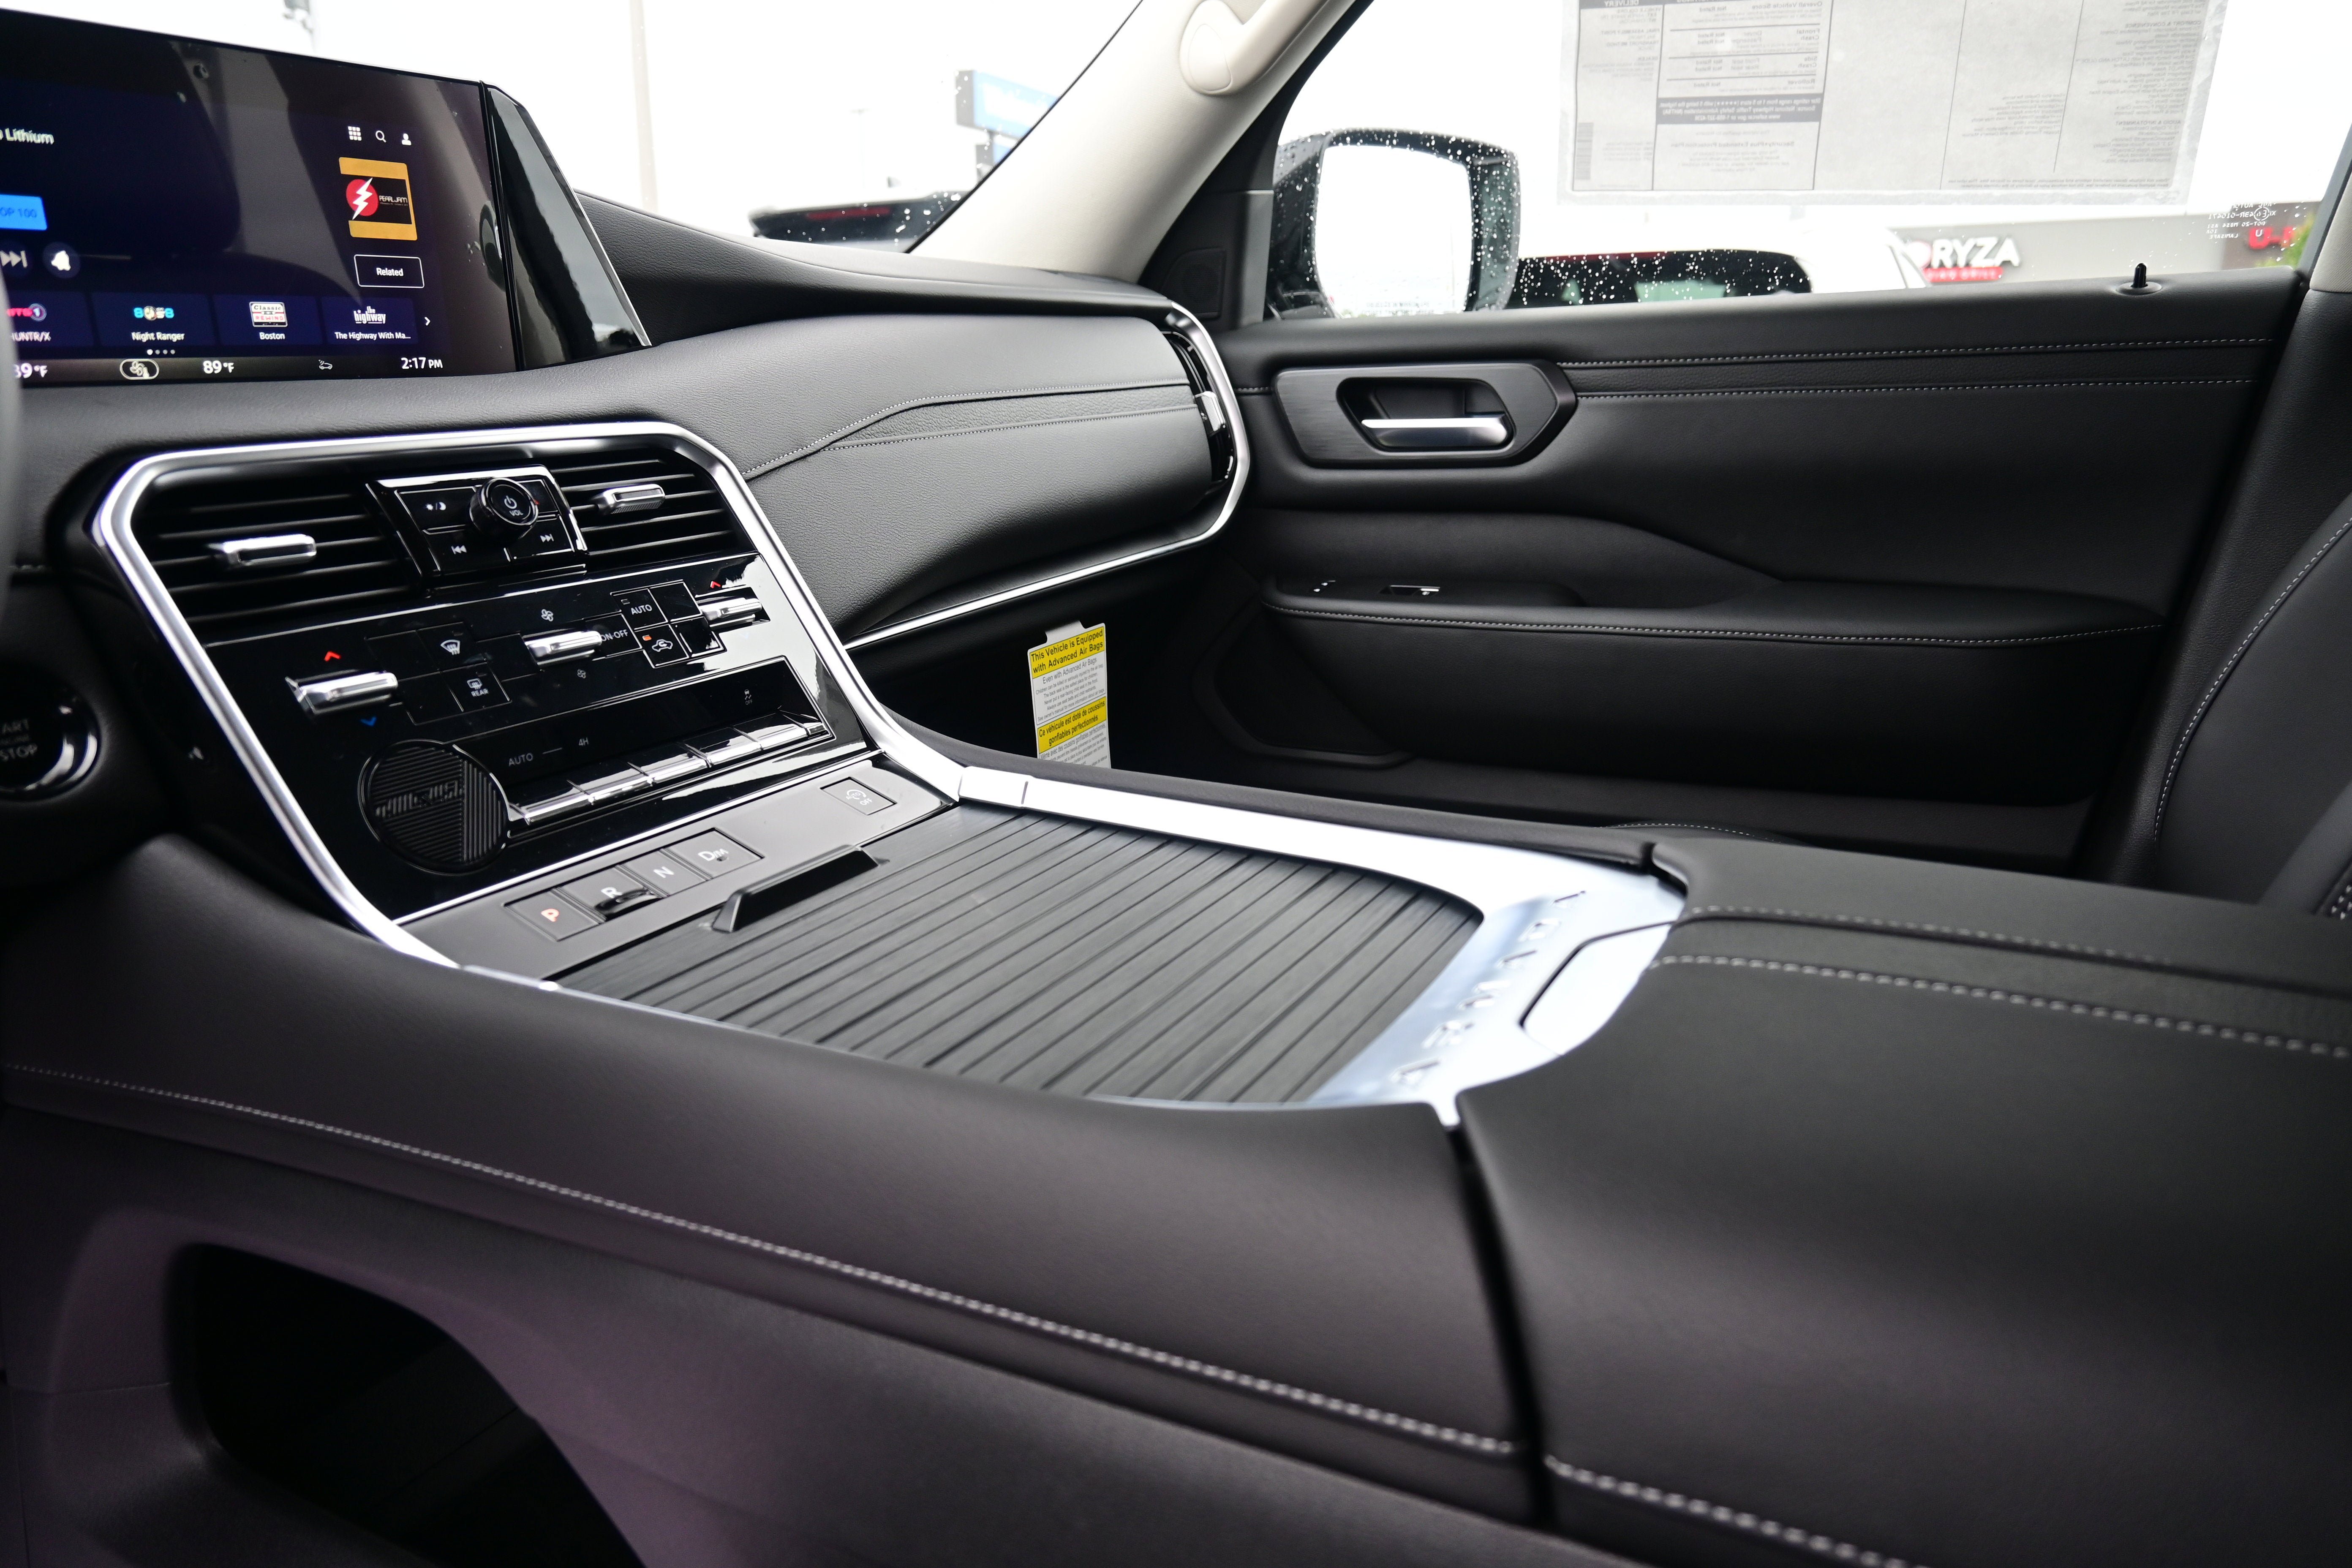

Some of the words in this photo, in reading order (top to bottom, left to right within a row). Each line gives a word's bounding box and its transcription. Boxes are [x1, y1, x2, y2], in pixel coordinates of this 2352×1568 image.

[5, 128, 54, 145] Lithium
[376, 267, 404, 276] Related
[354, 310, 386, 324] highway
[131, 332, 155, 343] Night
[156, 332, 185, 343] Ranger
[259, 332, 286, 340] Boston
[348, 332, 377, 341] Highway
[401, 357, 426, 370] 2:17
[428, 359, 443, 369] PM
[631, 604, 653, 616] AUTO
[1031, 651, 1044, 662] This
[1045, 643, 1068, 656] Vehicle
[1076, 629, 1102, 645] Equipped
[1033, 662, 1046, 673] with
[1048, 650, 1077, 667] Advanced
[1079, 647, 1087, 656] Air
[1089, 642, 1103, 652] Bags
[1043, 675, 1053, 684] Even
[1054, 671, 1062, 679] with
[1063, 663, 1081, 675] Advanced
[471, 689, 489, 697] REAR
[1039, 729, 1045, 737] Ce
[1046, 720, 1064, 733] véhicule
[1072, 711, 1081, 721] doté
[1088, 701, 1105, 713] coussins
[1049, 729, 1070, 746] gonflables
[1071, 715, 1098, 735] perfectionnés
[578, 737, 589, 747] 4H
[509, 752, 534, 767] AUTO
[653, 866, 674, 879] N
[601, 886, 623, 900] R
[541, 908, 560, 922] P
